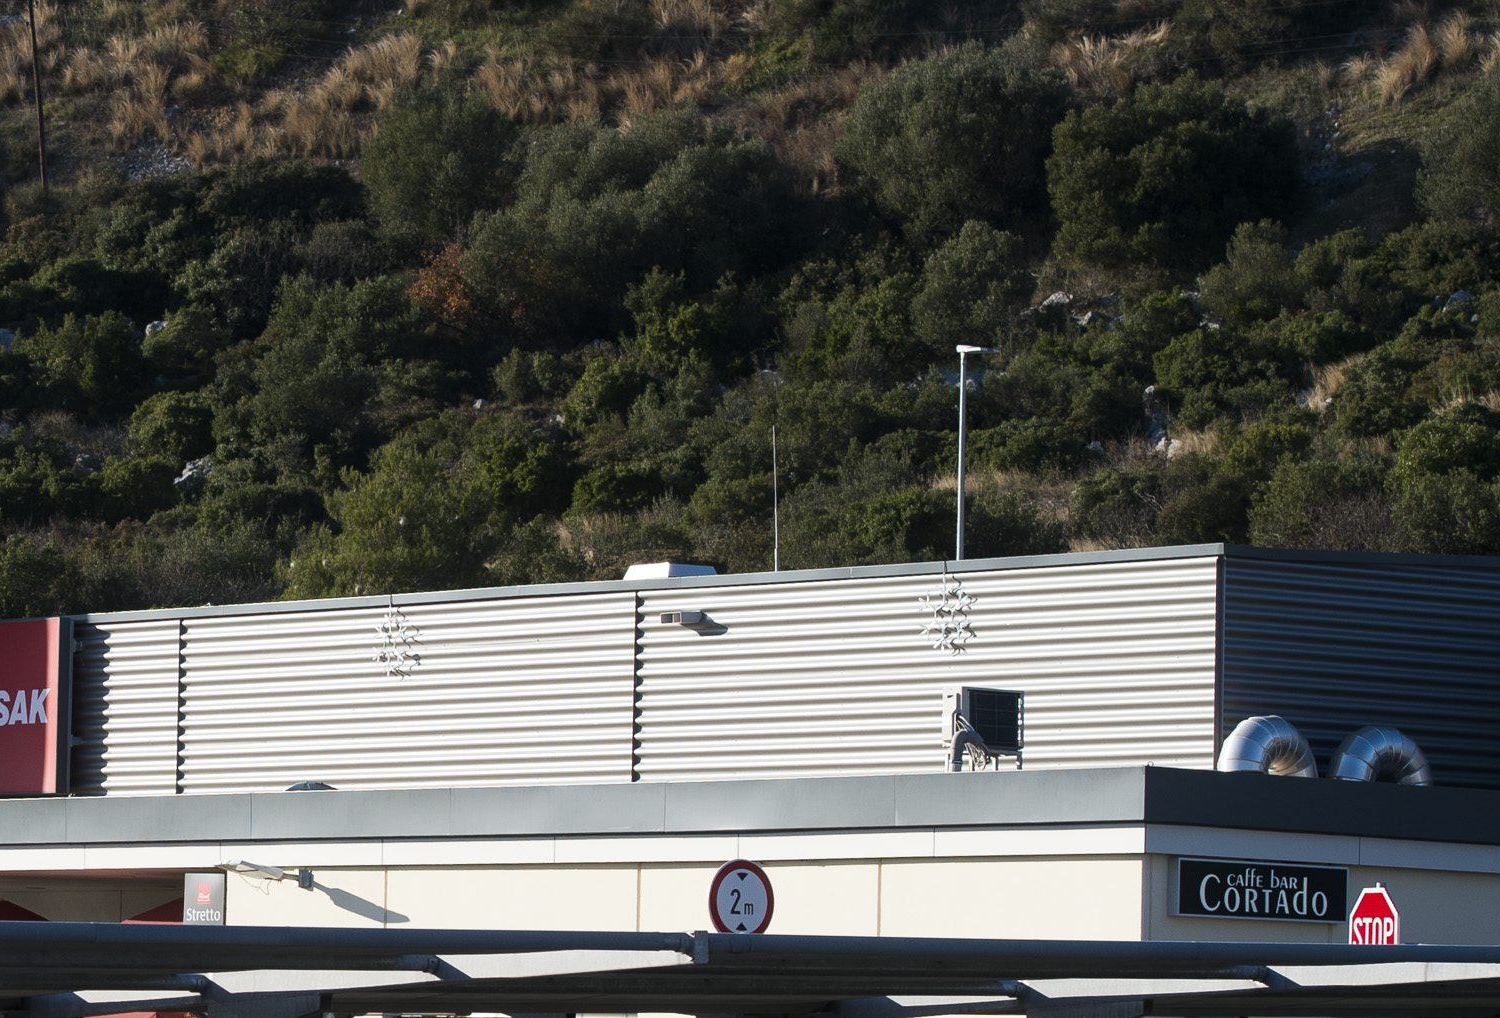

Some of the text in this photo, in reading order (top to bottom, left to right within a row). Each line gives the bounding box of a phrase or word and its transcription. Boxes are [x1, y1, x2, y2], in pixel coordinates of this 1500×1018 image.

[186, 907, 221, 922] Stretto
[731, 889, 754, 916] 2 m
[1353, 916, 1394, 945] STOP
